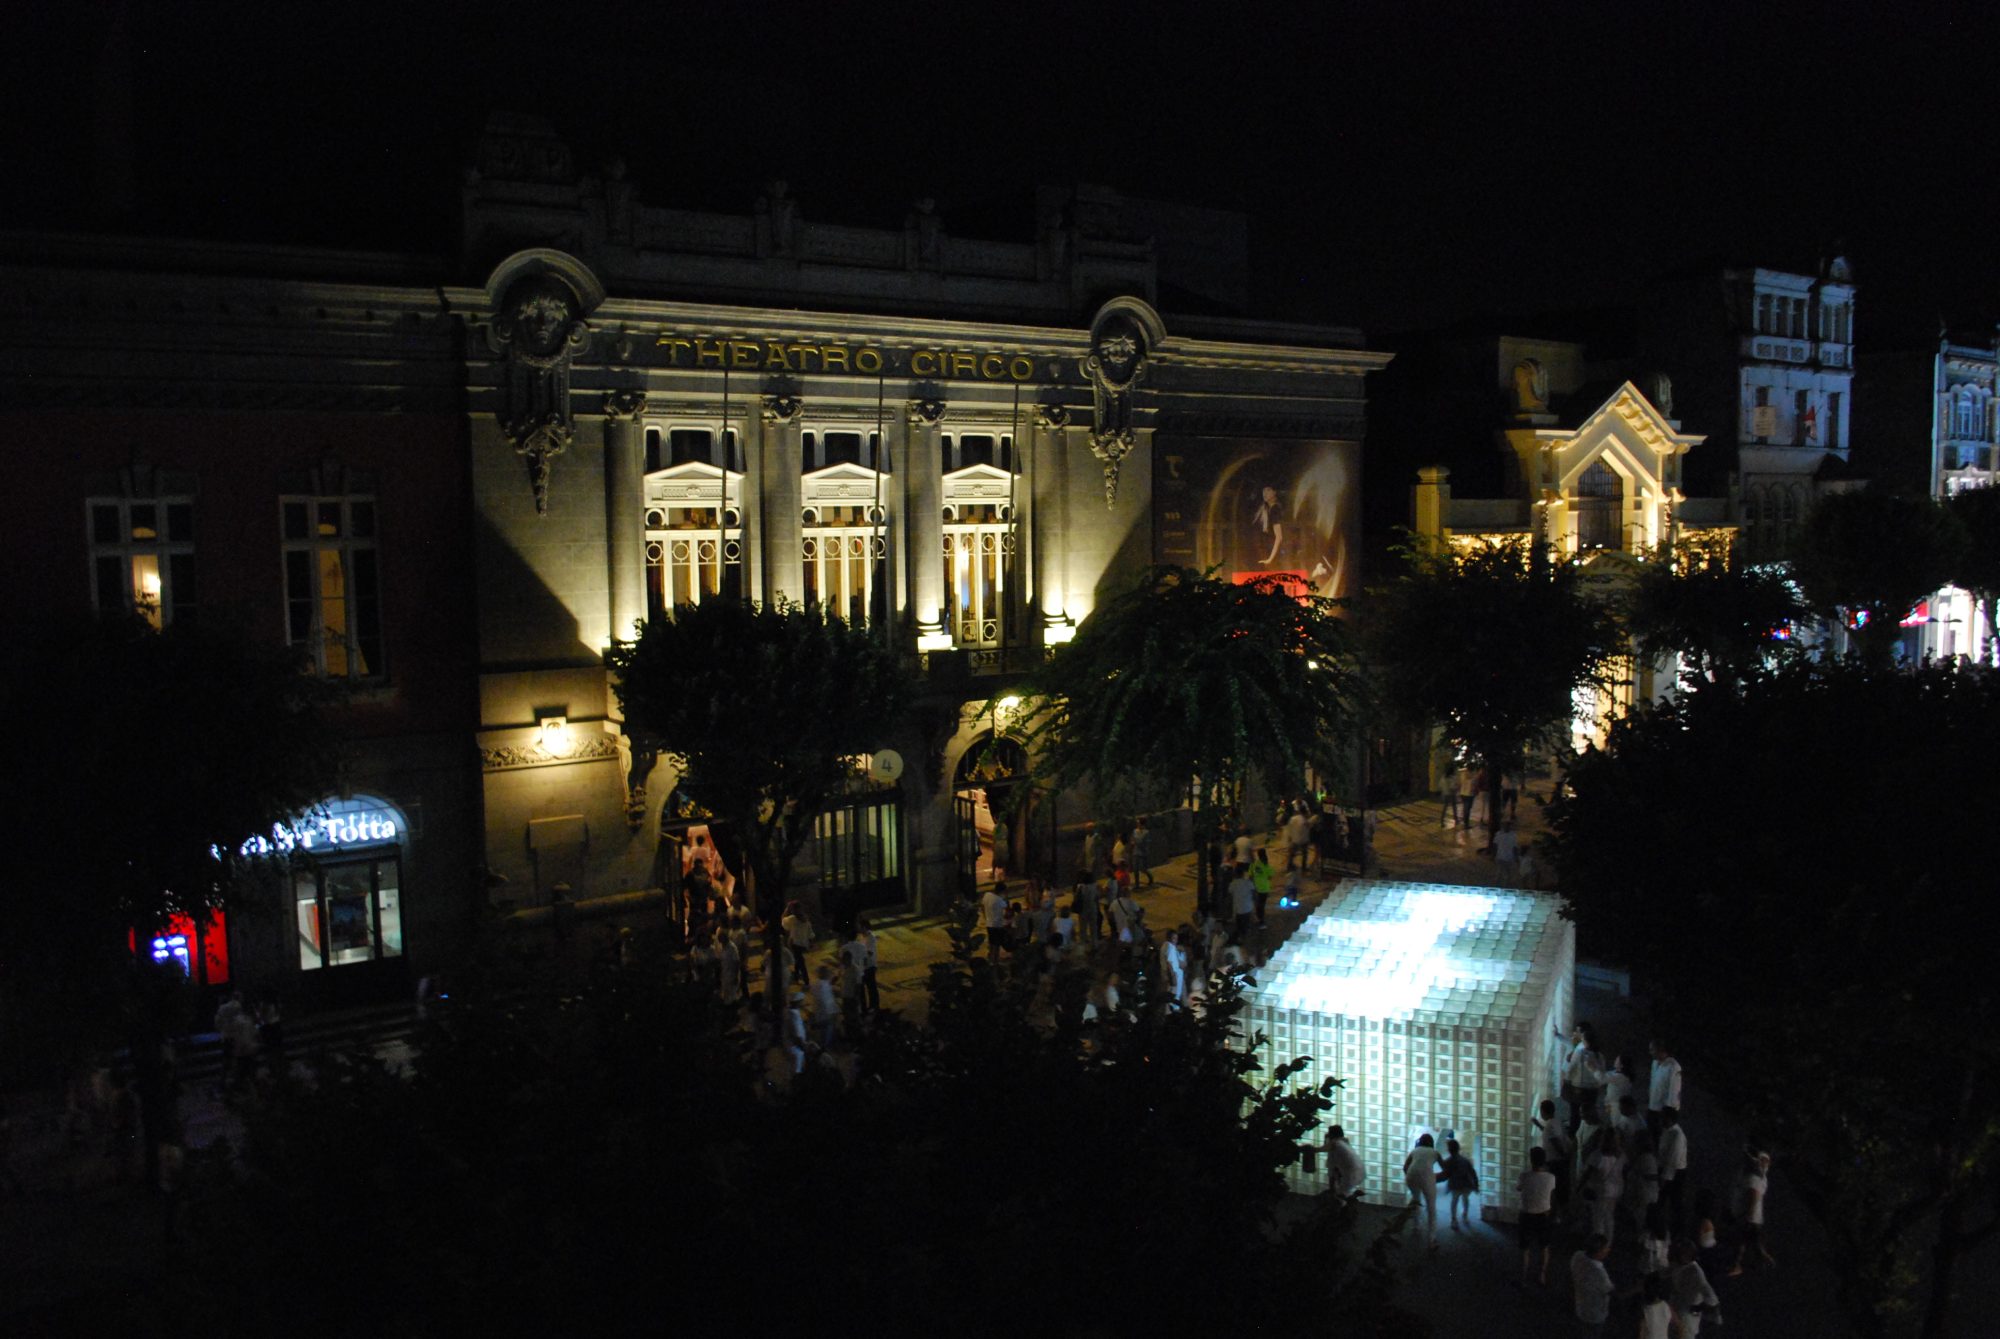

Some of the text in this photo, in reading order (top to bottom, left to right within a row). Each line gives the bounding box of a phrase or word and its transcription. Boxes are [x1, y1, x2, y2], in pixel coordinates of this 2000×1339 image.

[655, 337, 1034, 381] THEATRO CIRCO
[881, 758, 893, 773] 4
[321, 817, 397, 845] Totta
